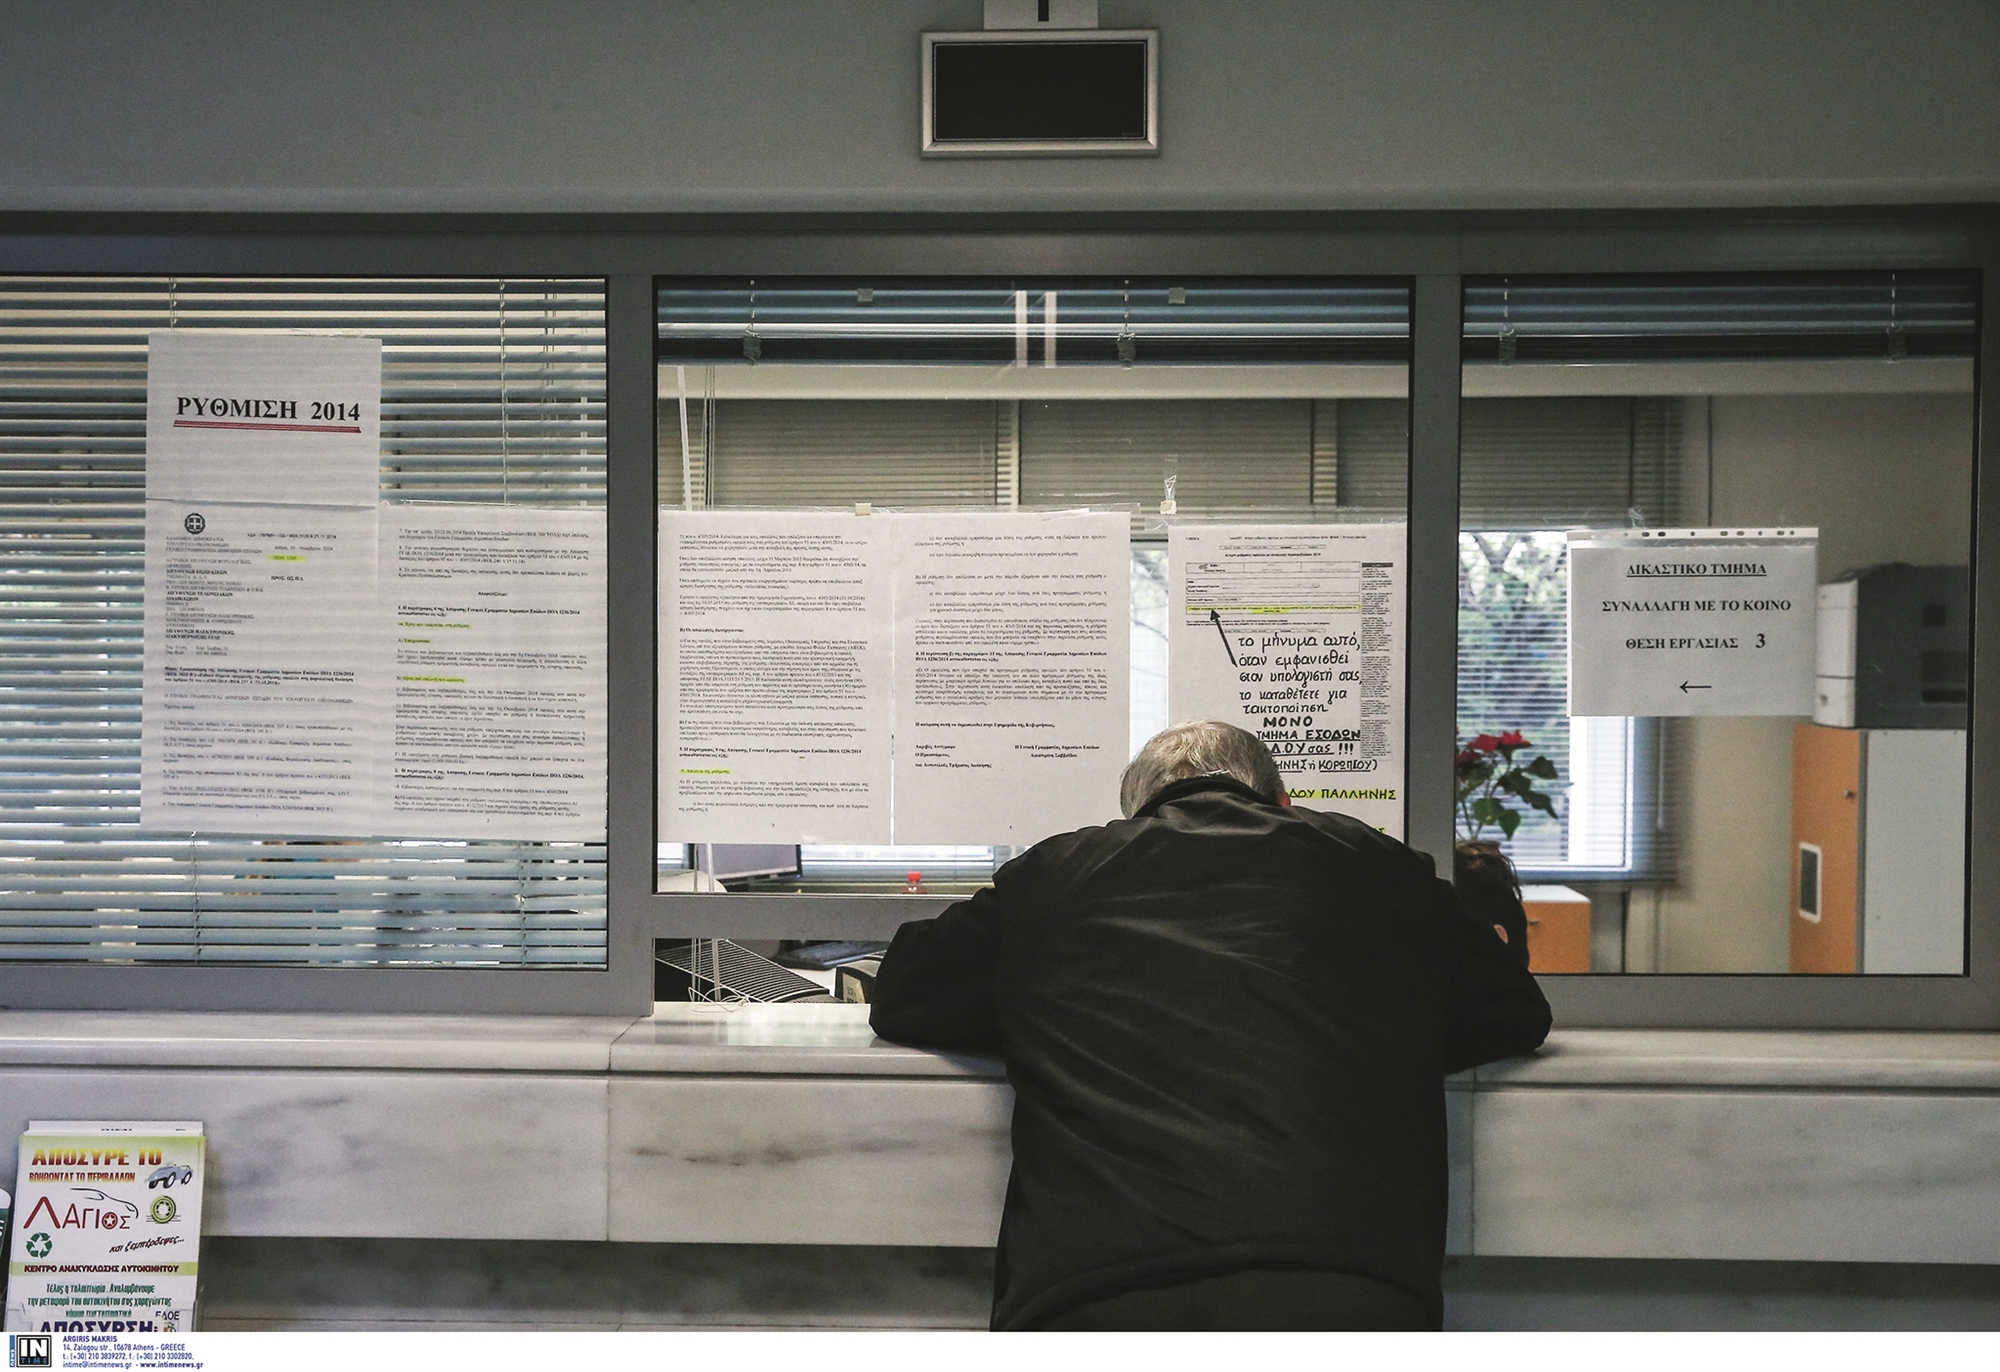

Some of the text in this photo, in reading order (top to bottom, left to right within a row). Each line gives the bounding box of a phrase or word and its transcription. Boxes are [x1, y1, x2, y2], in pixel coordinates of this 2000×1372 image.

[177, 397, 360, 421] ΡΥΘΜΙΣΗ 2014
[1627, 563, 1767, 576] ΔΙΚΑΣΤΙΚΟ ΤΜΗΜΑ
[1602, 600, 1791, 612] ΣΥΝΑΛΛΑΓΗ ΜΕ ΤΟ ΚΟΙΝΟ
[1238, 631, 1361, 653] το μήνυμα αυτό,
[1625, 633, 1766, 649] ΘΕΣΗ ΕΡΓΑΣΙΑΣ 3
[1238, 649, 1349, 670] όταν εμφανισθεί
[1270, 668, 1333, 688] υπολογιστή
[1239, 687, 1348, 705] το καταθέτετε για
[1242, 702, 1329, 714] τακτοποίηση
[1263, 715, 1313, 728] ΜΟΝΟ
[1255, 729, 1361, 741] ΤΜΗΜΑ ΕΣΟΔΩΝ
[1321, 788, 1397, 800] ΠΑΛΛΗΝΗΣ
[31, 1148, 163, 1166] ΑΠΟΣΥΡΕ ΤΟ
[75, 1172, 86, 1183] ΤΟ
[24, 1264, 179, 1273] ΚΕΝΤΡΟ ΑΝΑΚΥΚΛΩΣΗΣ ΑΥΤΟΚΙΝΗΤΟΥ
